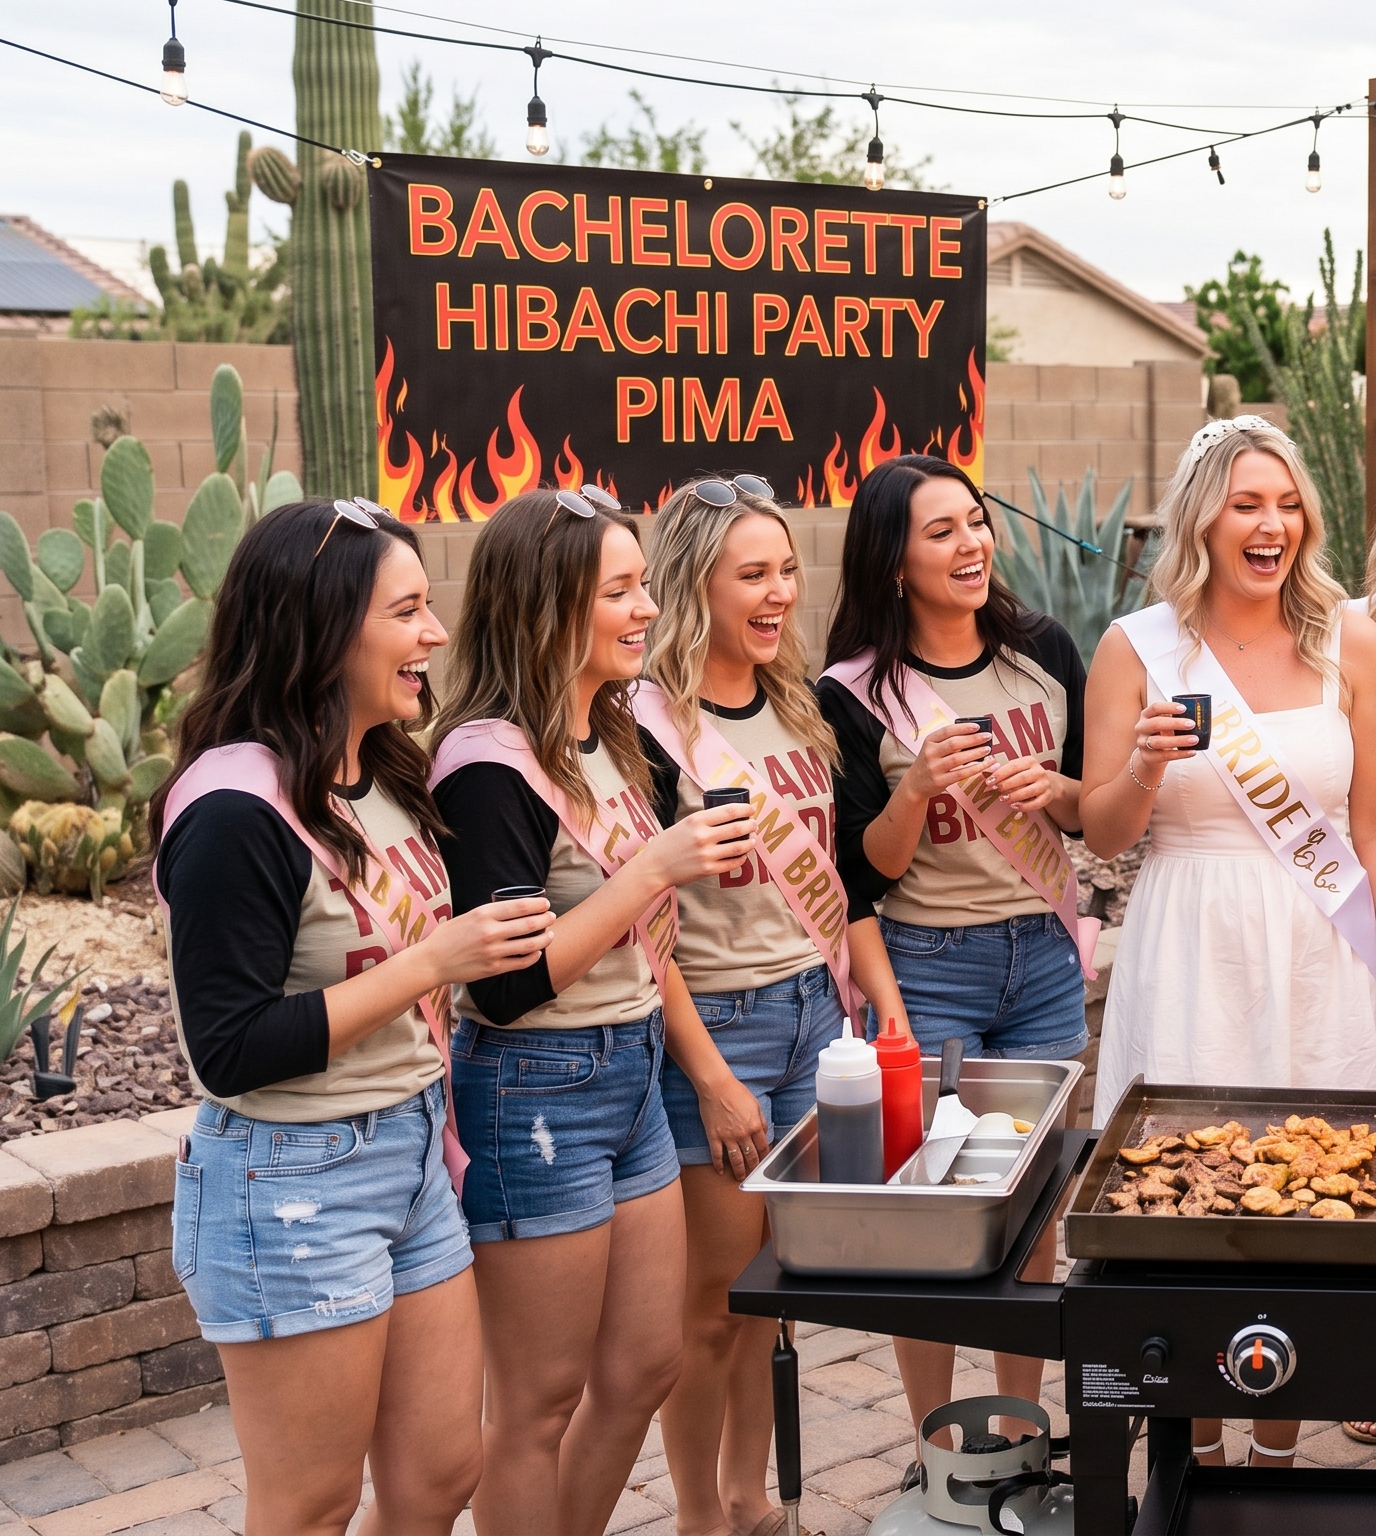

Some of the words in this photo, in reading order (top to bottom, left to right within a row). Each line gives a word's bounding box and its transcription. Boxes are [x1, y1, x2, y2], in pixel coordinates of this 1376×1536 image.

[407, 183, 963, 279] BACHELORETTE
[435, 282, 728, 355] HIBACHI
[753, 293, 945, 358] PARTY
[616, 377, 793, 442] PIMA
[984, 702, 1056, 760] AM
[1211, 702, 1311, 840] BRIDE
[749, 746, 833, 801] AM
[328, 829, 448, 938] TAM
[995, 811, 1071, 903] BRIDE
